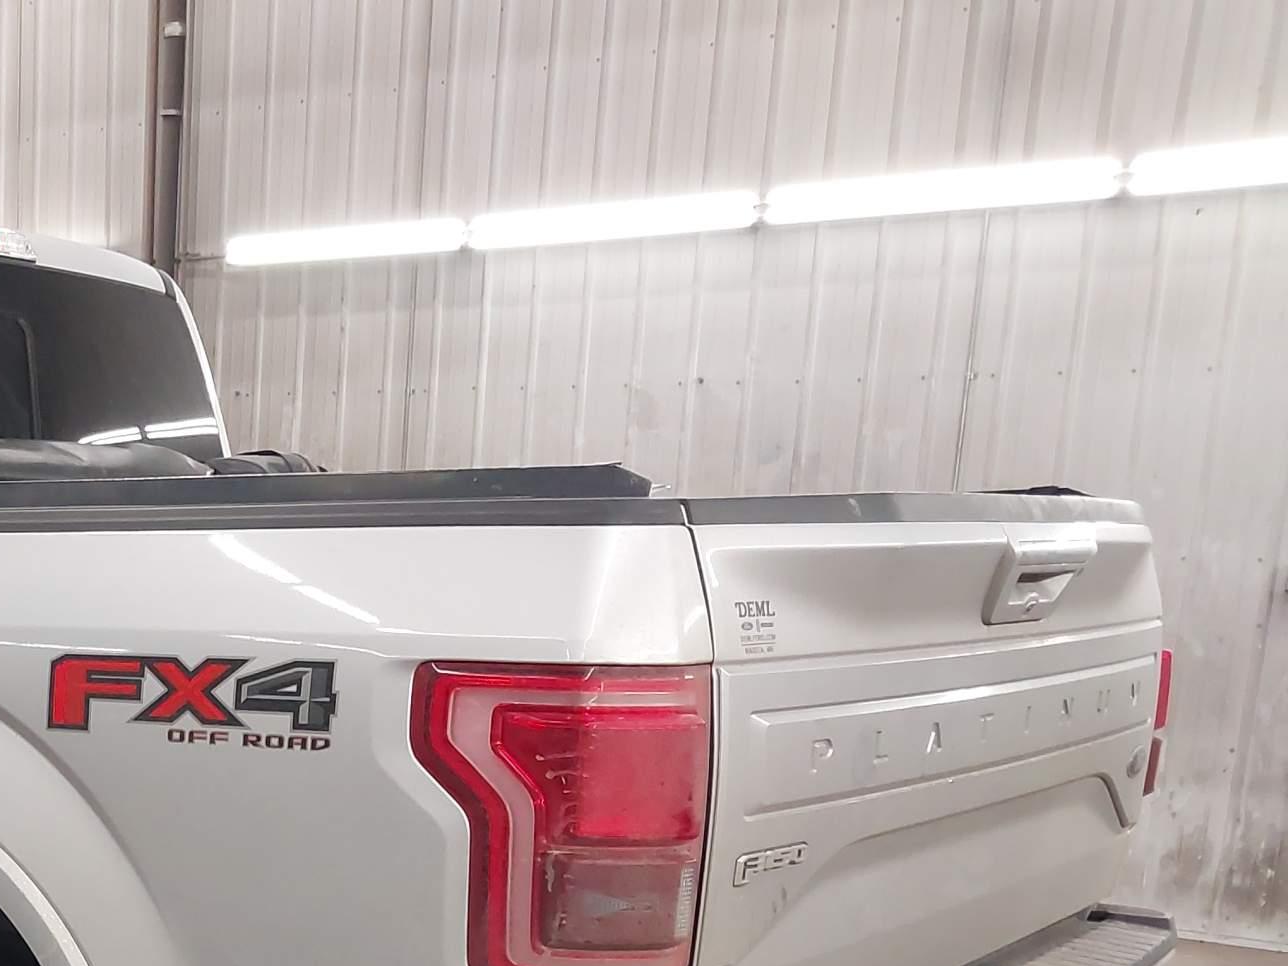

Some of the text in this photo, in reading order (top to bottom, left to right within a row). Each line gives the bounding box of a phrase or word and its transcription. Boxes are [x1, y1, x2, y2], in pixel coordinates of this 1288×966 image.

[734, 600, 776, 618] DEML
[46, 653, 340, 733] FX4
[167, 728, 332, 751] OFF ROAD
[810, 679, 1142, 775] PLATINUM
